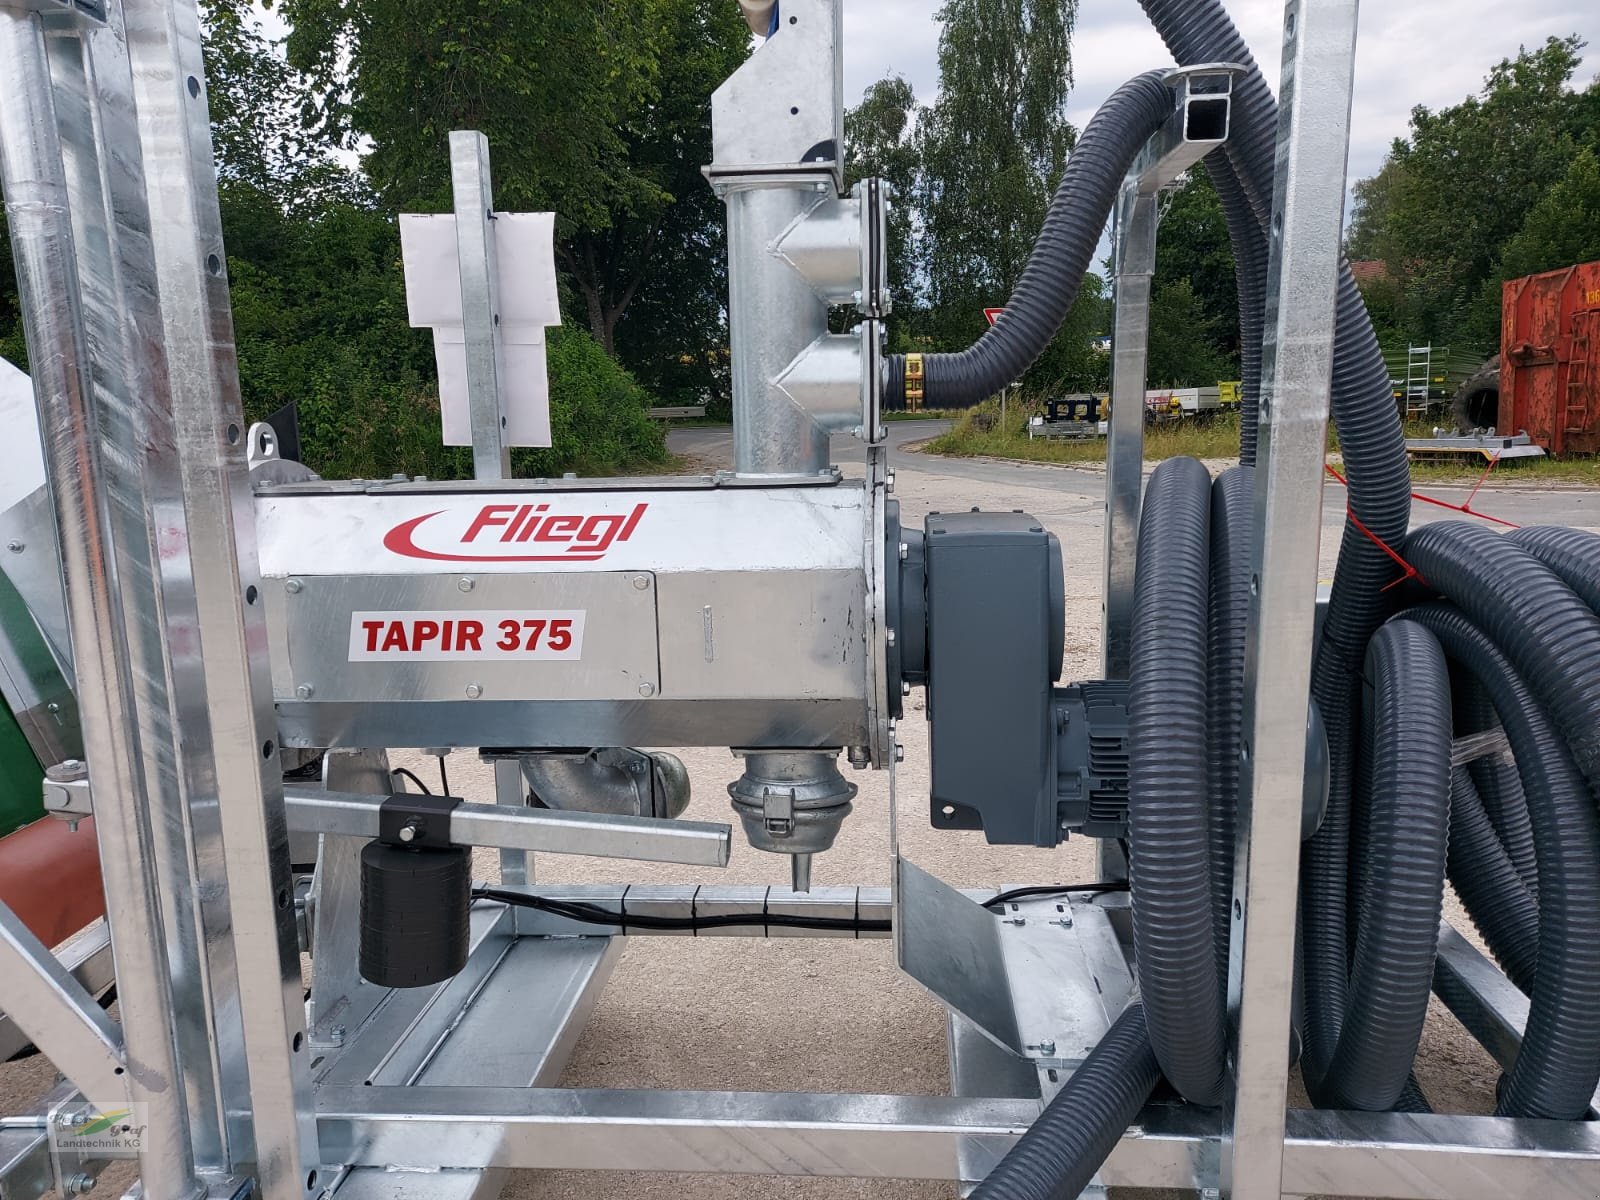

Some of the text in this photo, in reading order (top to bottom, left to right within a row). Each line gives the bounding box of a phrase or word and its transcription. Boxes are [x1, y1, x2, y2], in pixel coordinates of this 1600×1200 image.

[459, 503, 649, 552] Fliegl
[362, 619, 573, 652] TAPIR 375
